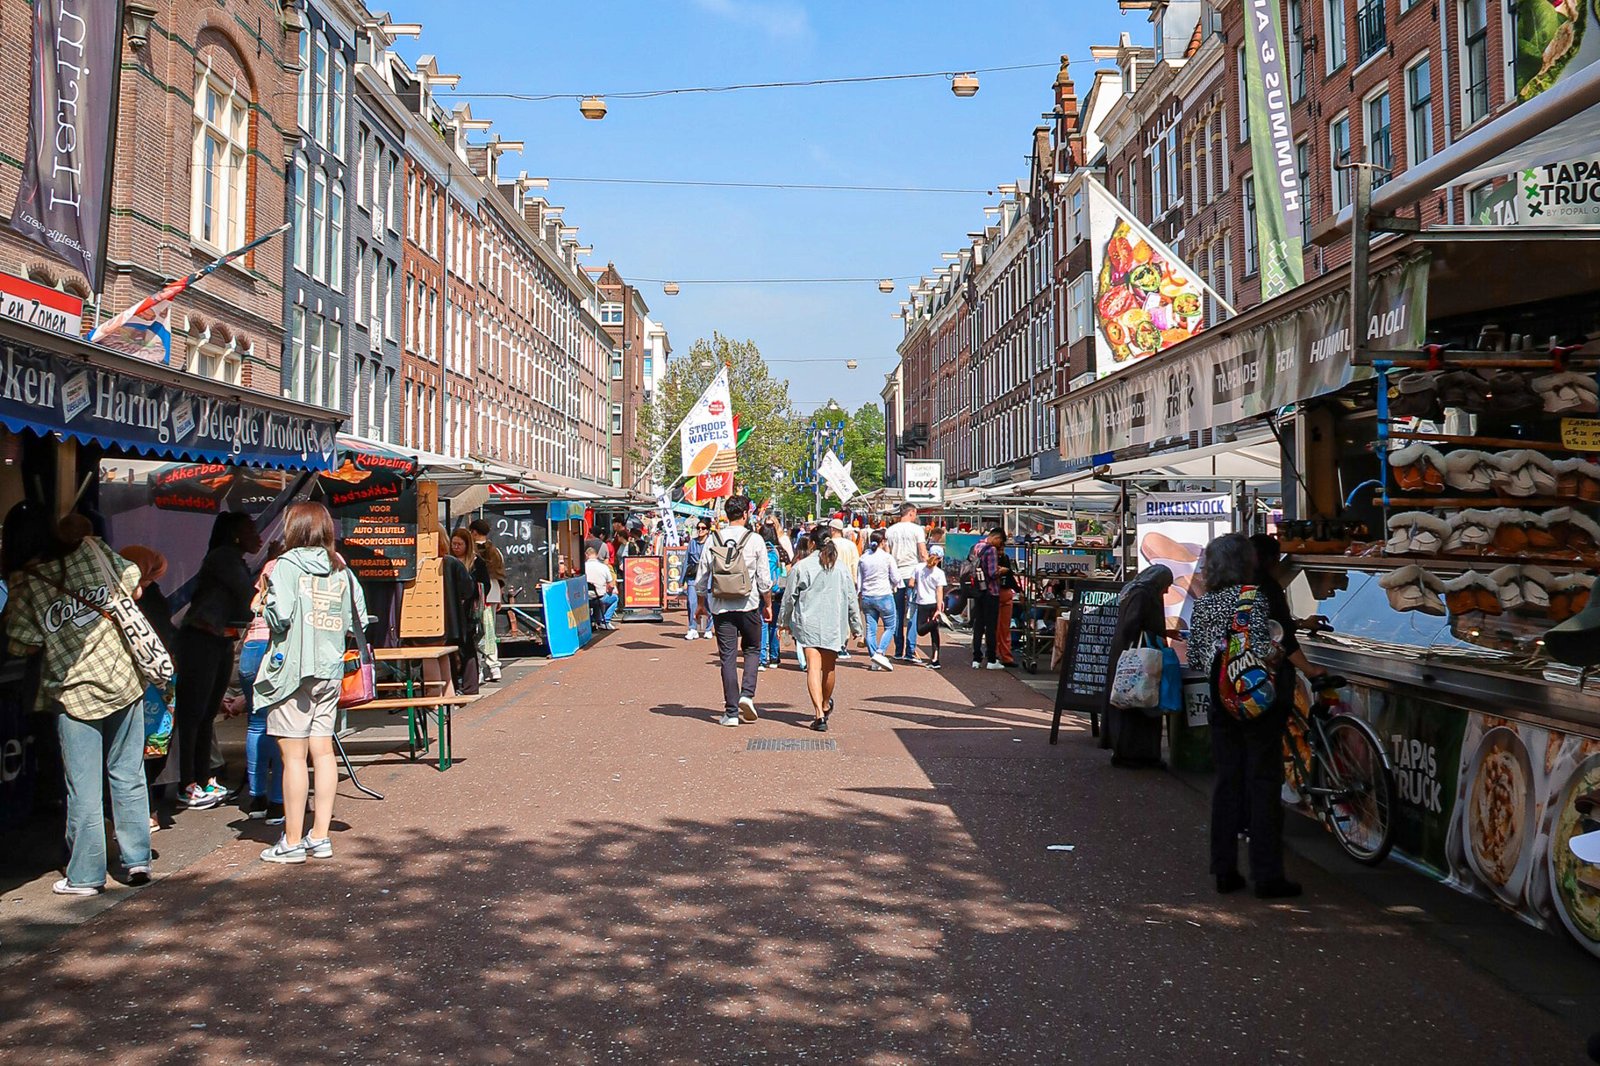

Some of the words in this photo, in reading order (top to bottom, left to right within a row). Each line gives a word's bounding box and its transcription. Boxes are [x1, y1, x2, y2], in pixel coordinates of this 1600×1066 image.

[1546, 209, 1557, 217] BY
[1560, 207, 1589, 216] POPAL
[8, 301, 24, 319] en
[29, 300, 66, 333] Zonen
[1275, 346, 1295, 374] FETA
[1366, 304, 1407, 341] AIOLI
[92, 368, 170, 444] Haring
[197, 395, 259, 454] Belegde
[688, 420, 727, 436] STROOP
[688, 430, 729, 445] WAFELS
[356, 453, 413, 474] Kibbeling
[908, 480, 938, 488] BOZZ
[369, 505, 391, 513] VOOR
[1146, 500, 1225, 516] BIRKENSTOCK
[353, 526, 373, 534] AUTO
[374, 526, 406, 534] SLEUTELS
[506, 543, 534, 556] VOOR
[391, 559, 407, 567] VAN
[1044, 561, 1090, 573] BIRKENSTOCK
[1391, 734, 1437, 778] TAPAS
